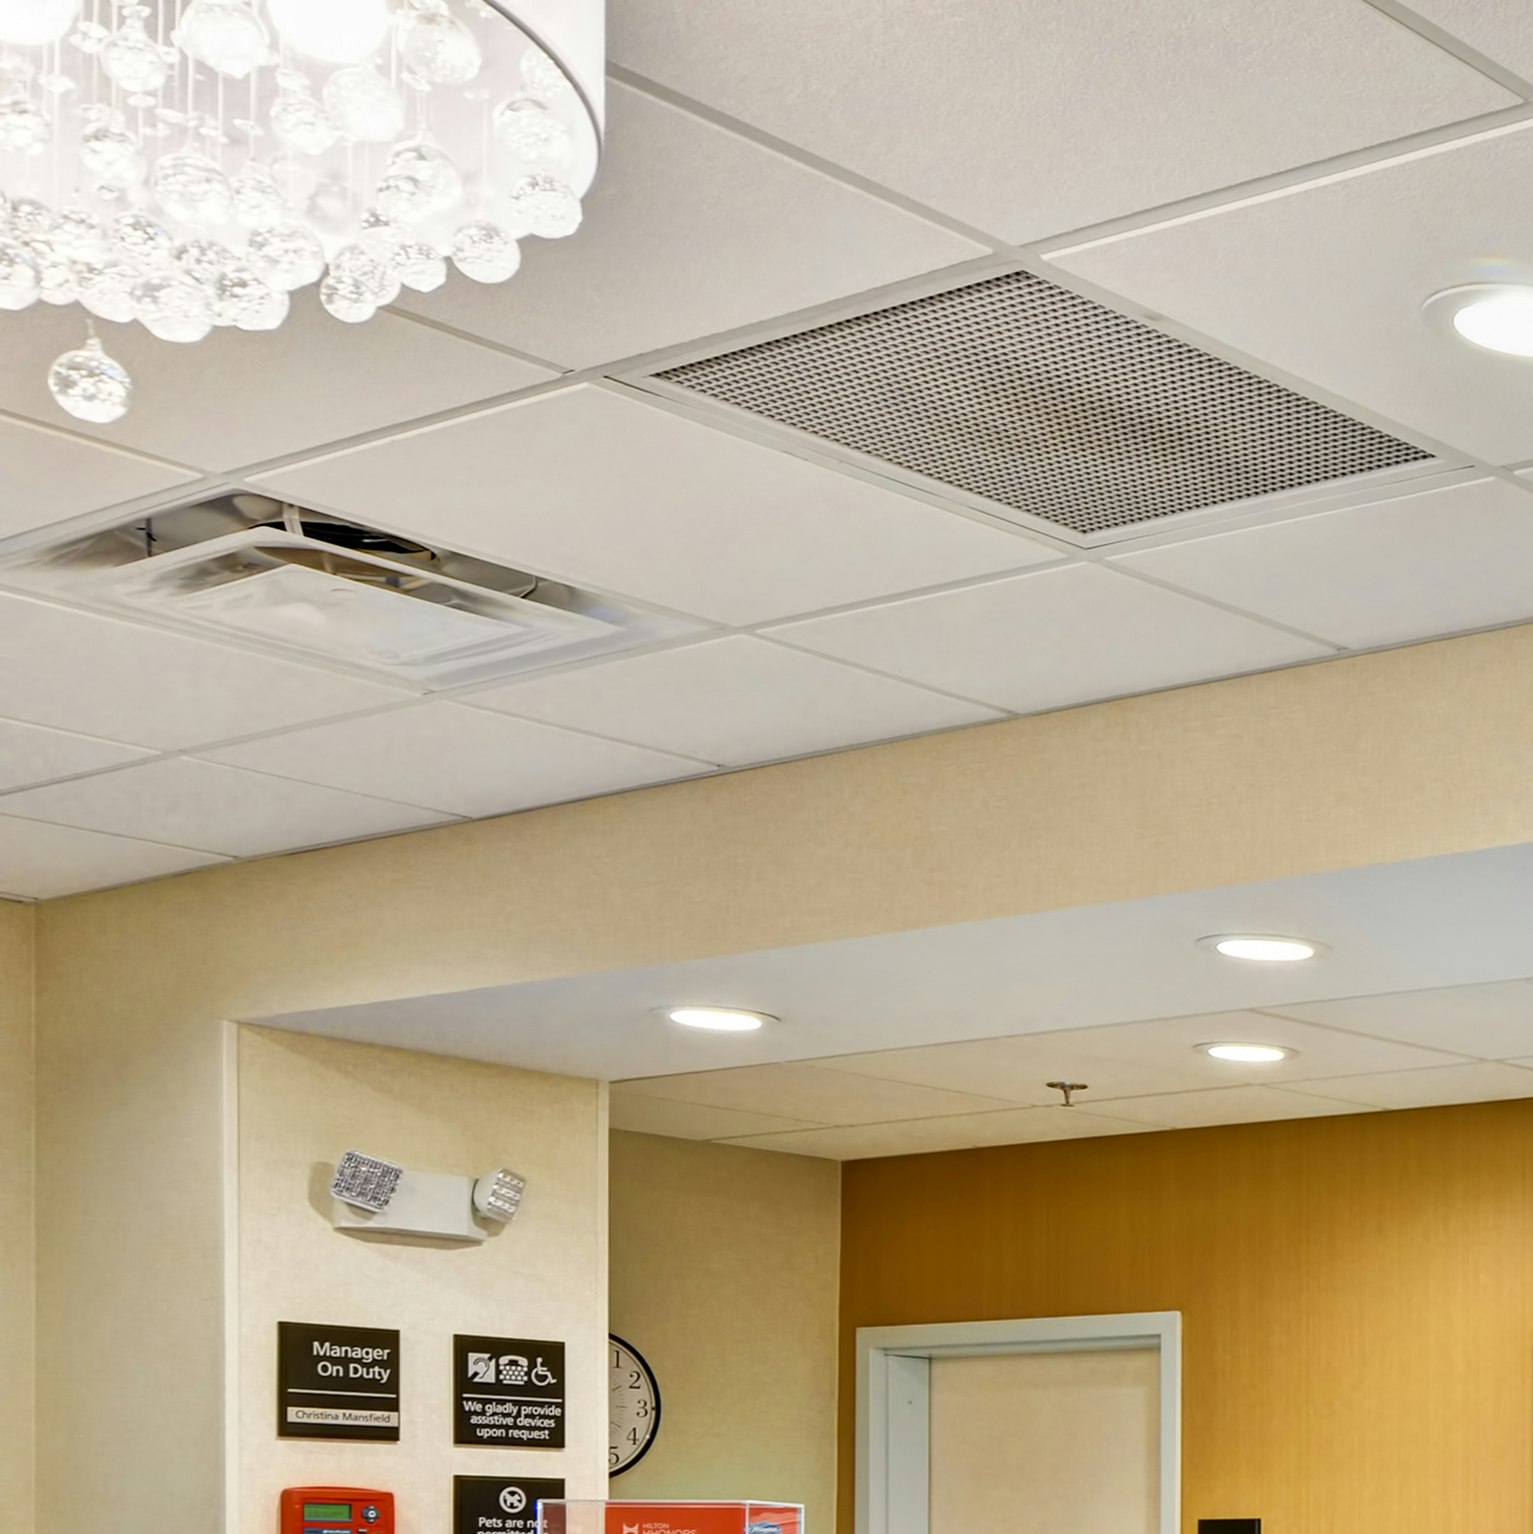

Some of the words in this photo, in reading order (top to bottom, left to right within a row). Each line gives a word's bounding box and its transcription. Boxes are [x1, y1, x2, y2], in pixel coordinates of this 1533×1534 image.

[312, 1341, 391, 1363] Manager
[317, 1361, 344, 1377] On
[348, 1363, 391, 1384] Duty
[463, 1401, 483, 1412] We
[485, 1402, 519, 1416] gladly
[521, 1405, 562, 1418] provide
[295, 1410, 339, 1421] Christina
[342, 1412, 391, 1423] Mansfield
[470, 1415, 515, 1426] assistive
[516, 1416, 556, 1428] devices
[476, 1428, 506, 1439] upon
[508, 1429, 550, 1441] request
[478, 1516, 503, 1528] Pets
[505, 1519, 524, 1528] are
